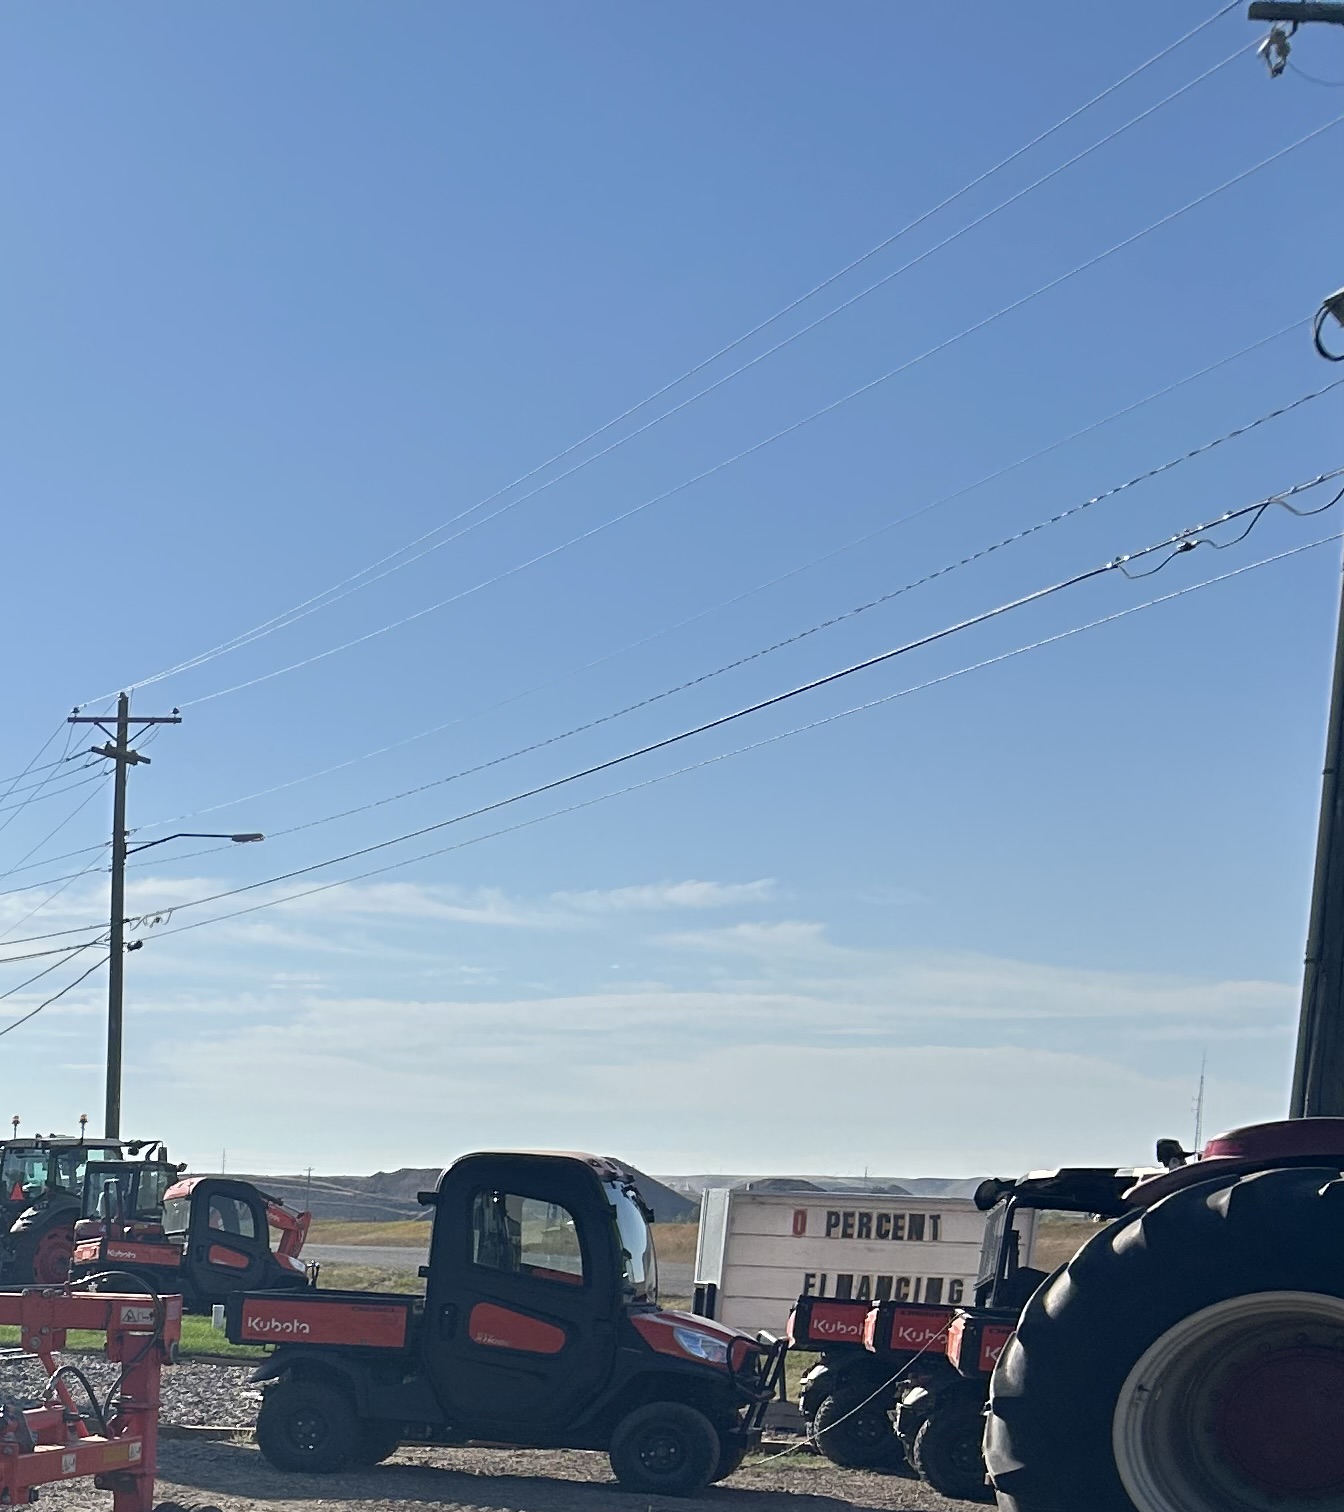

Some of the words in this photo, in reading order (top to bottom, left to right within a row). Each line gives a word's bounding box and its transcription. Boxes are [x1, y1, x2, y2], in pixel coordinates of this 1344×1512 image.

[825, 1210, 942, 1242] PERCENT
[802, 1273, 964, 1305] FINANCING
[247, 1316, 310, 1334] Kubota
[813, 1319, 866, 1337] Kubot
[898, 1326, 949, 1345] Kubo
